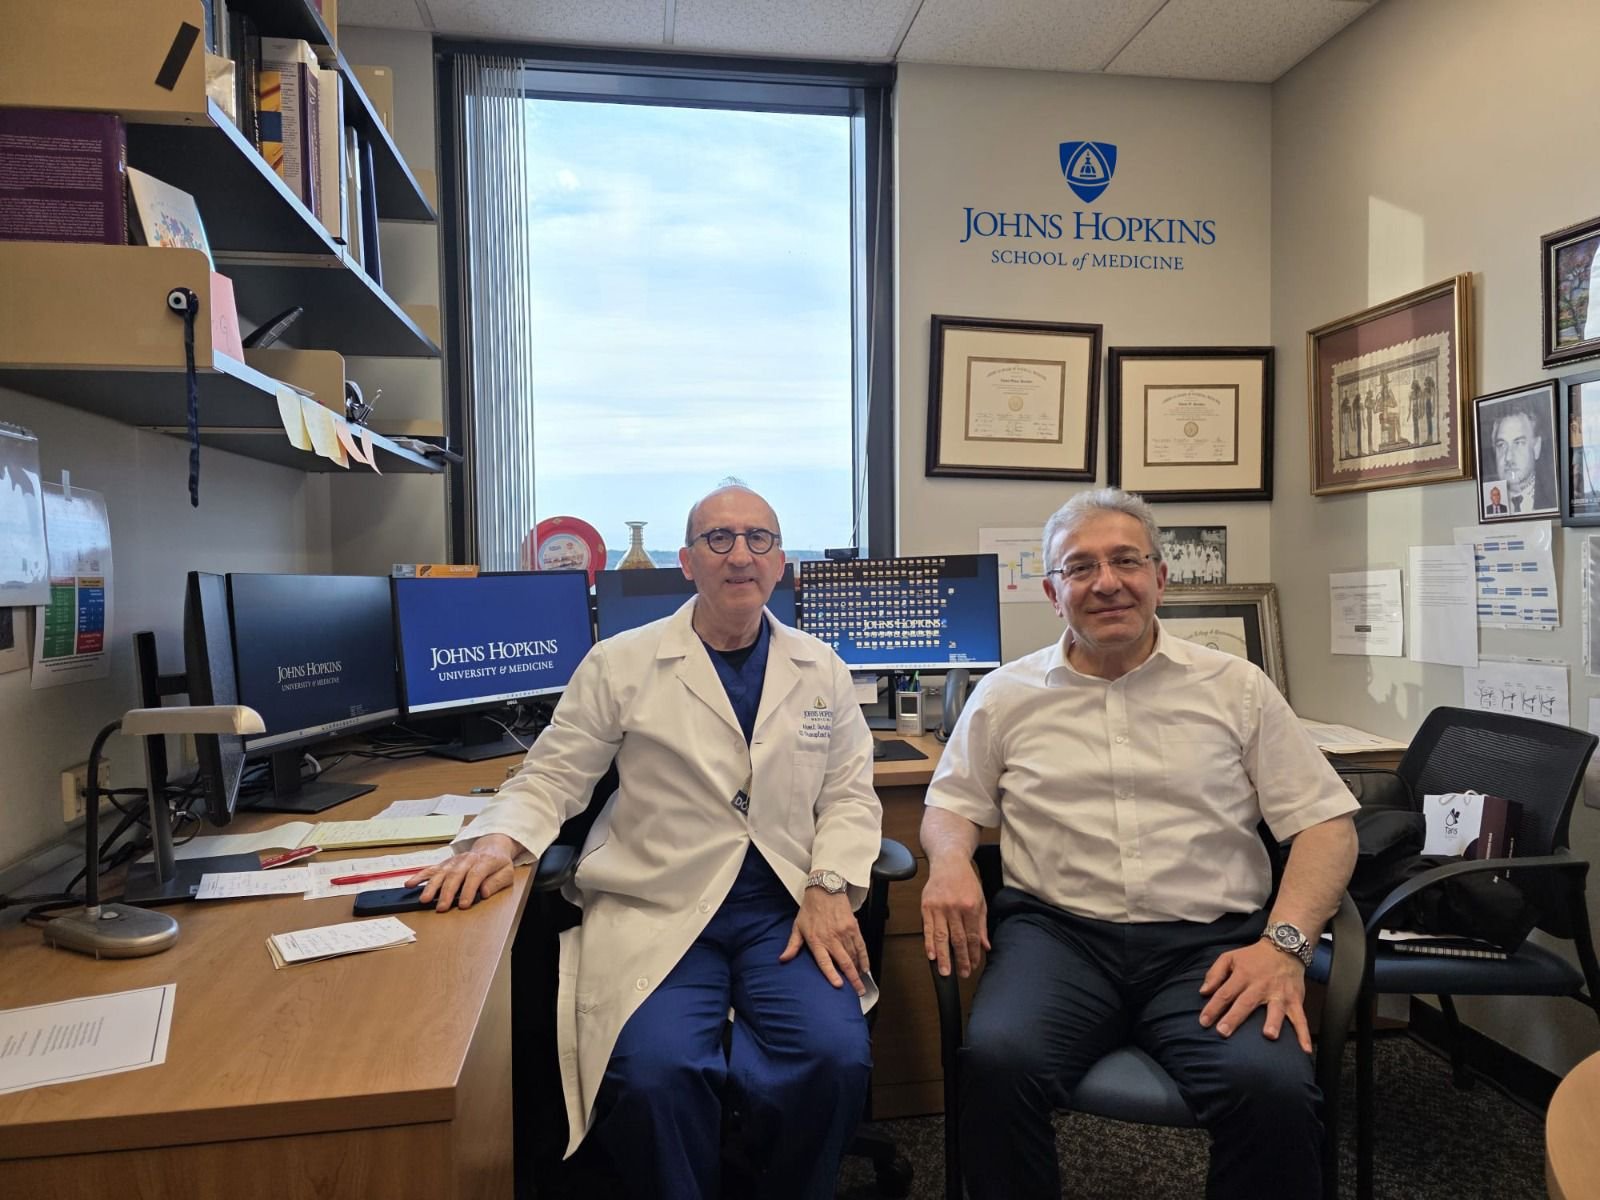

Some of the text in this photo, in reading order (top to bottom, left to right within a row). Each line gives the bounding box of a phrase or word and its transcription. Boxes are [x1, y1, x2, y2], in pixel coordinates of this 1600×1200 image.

[960, 207, 1217, 245] JOHNS HOPKINS
[991, 249, 1185, 271] SCHOOL of MEDICINE
[862, 618, 941, 632] JOHNS HOPKINS
[429, 639, 558, 671] JOHNS HOPKINS
[277, 660, 342, 684] JOHNS HOPKINS
[438, 660, 554, 682] UNIVERSITY & MEDICINE
[281, 681, 312, 692] UNIVERSITY
